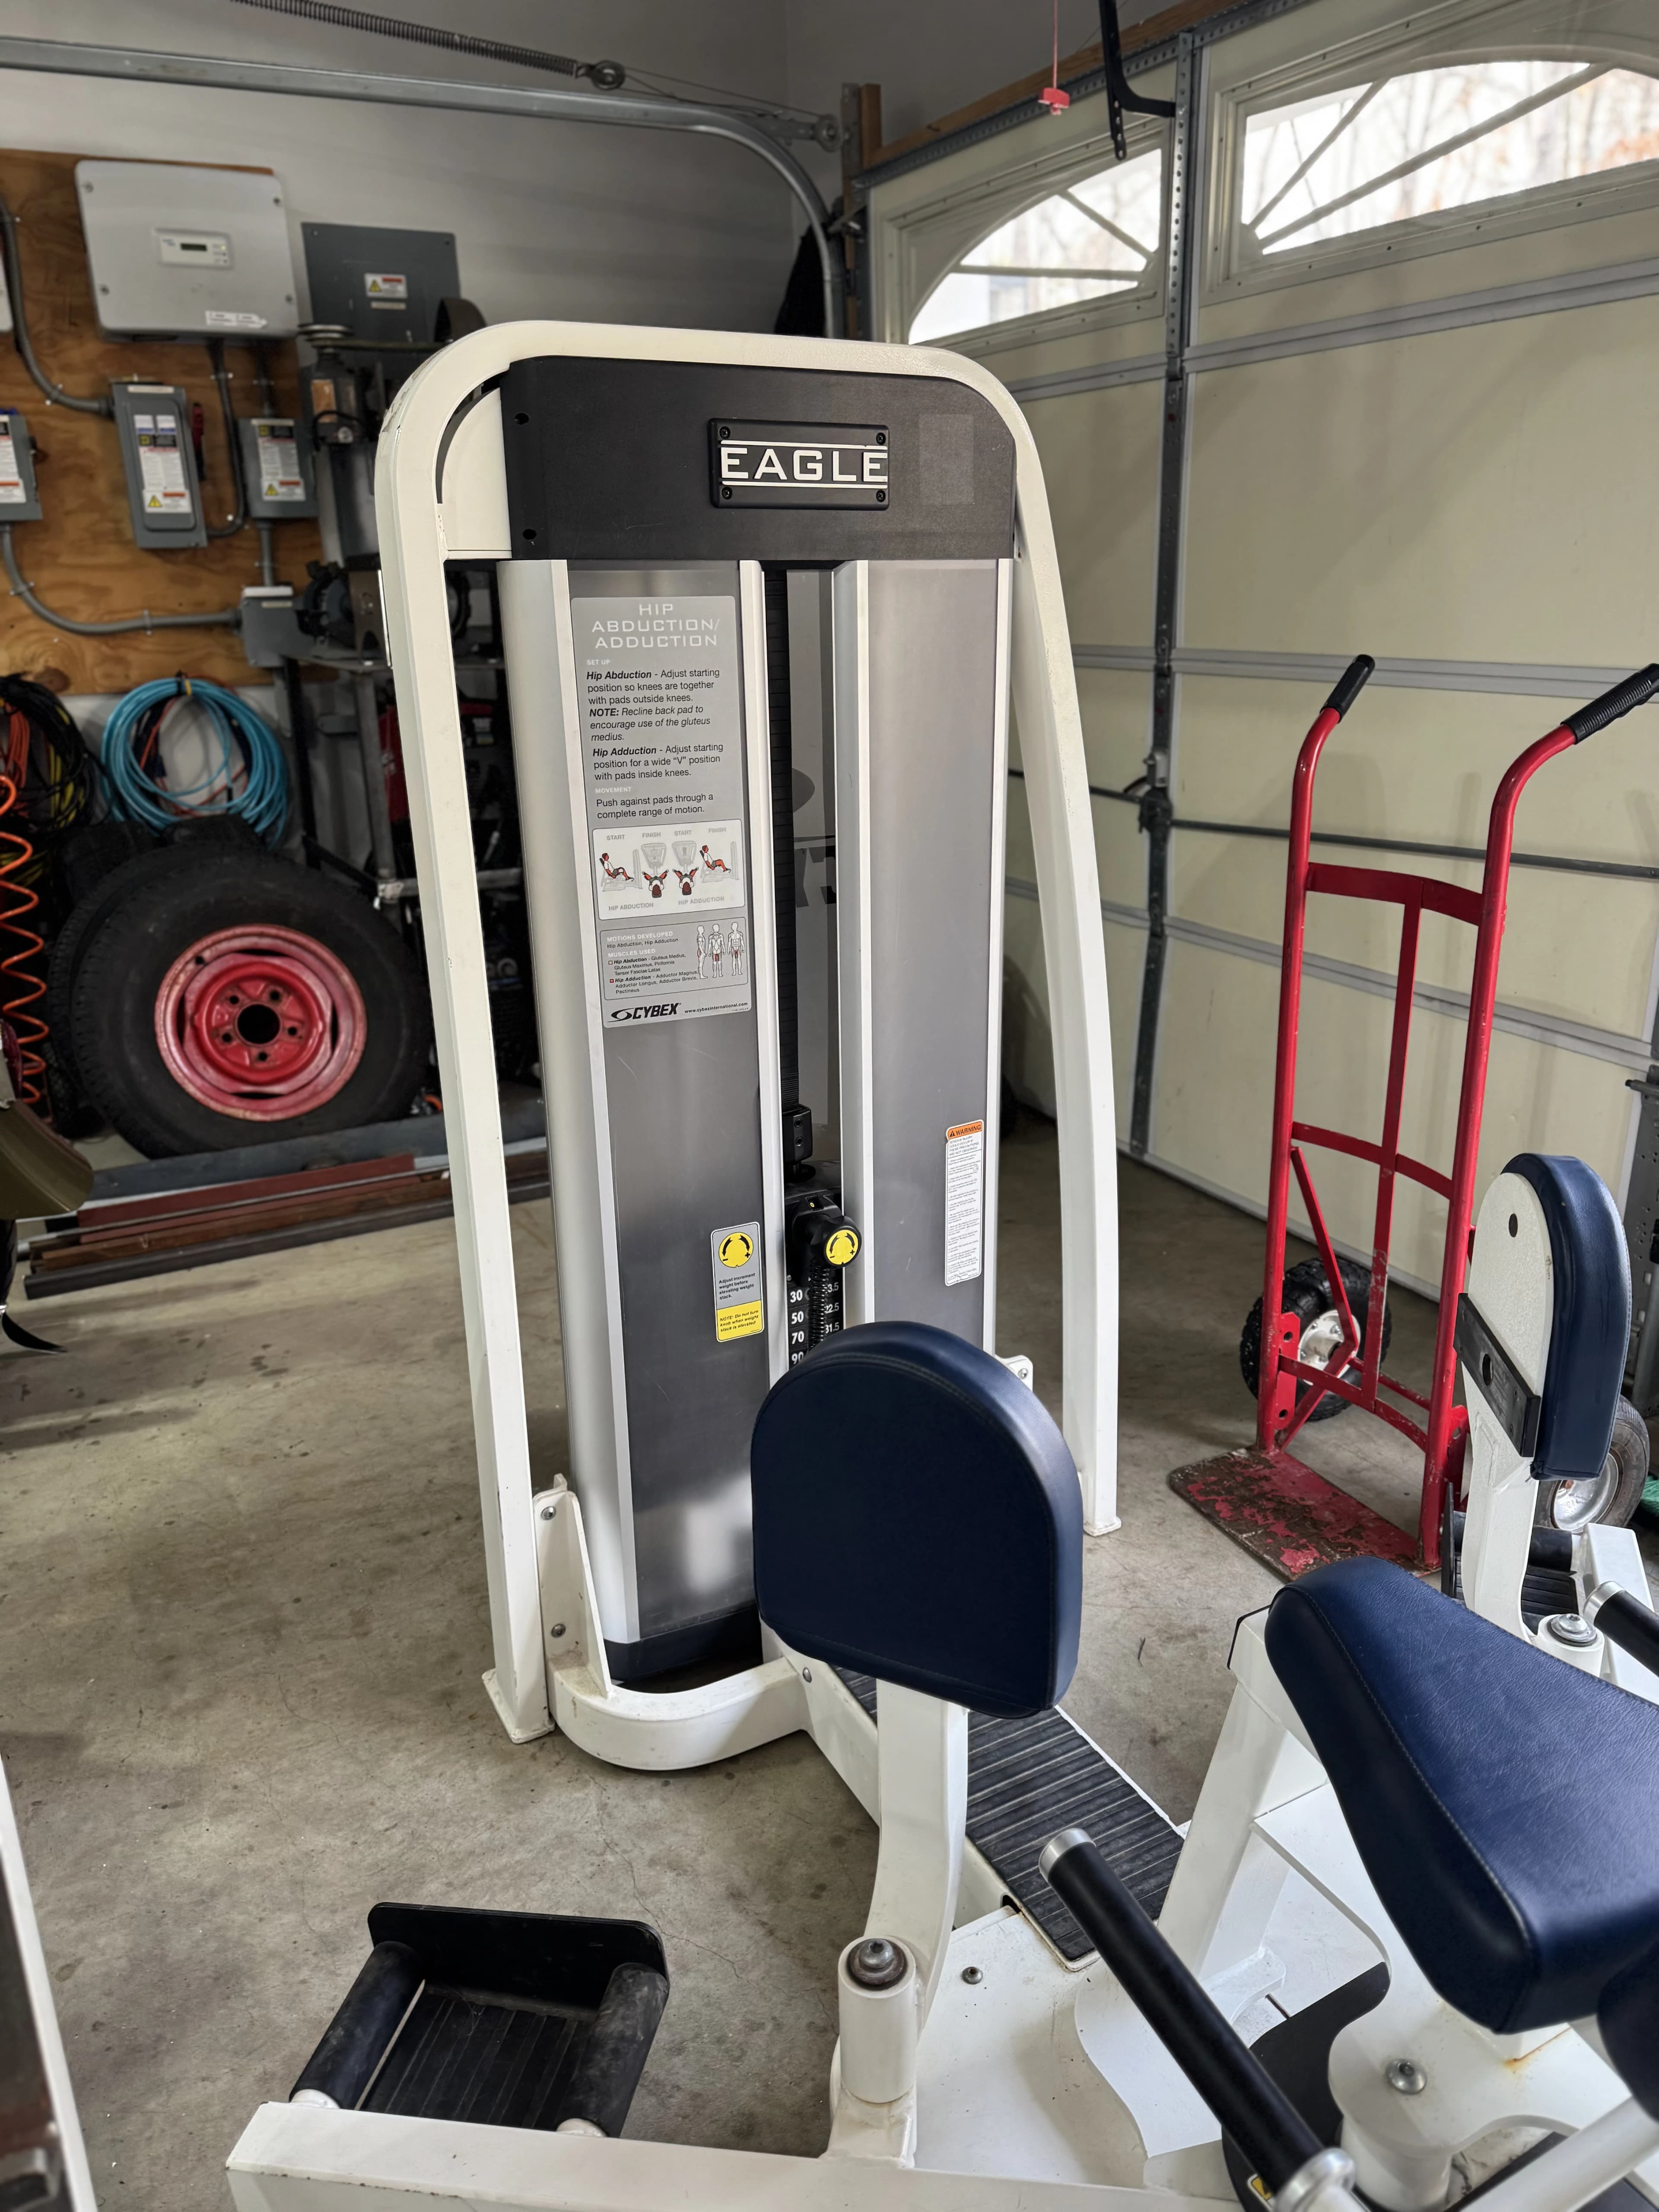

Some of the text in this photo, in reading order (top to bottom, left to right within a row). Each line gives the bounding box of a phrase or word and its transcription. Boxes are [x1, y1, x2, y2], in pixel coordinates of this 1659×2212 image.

[721, 447, 888, 482] EAGLE
[639, 604, 673, 615] HIP
[591, 619, 720, 632] ABDUCTION/
[595, 635, 717, 648] ADDUCTION
[587, 671, 602, 681] Hip
[605, 671, 652, 680] Abduction
[661, 669, 687, 679] Adjust
[689, 668, 720, 677] starting
[588, 683, 622, 693] position
[680, 681, 715, 691] together
[588, 696, 606, 705] with
[609, 696, 630, 706] pads
[632, 695, 664, 703] outside
[589, 708, 619, 717] NOTE:
[622, 707, 652, 716] Recline
[655, 706, 675, 715] back
[677, 706, 693, 715] pad
[590, 721, 636, 729] encourage
[655, 718, 664, 727] of
[681, 718, 711, 727] gluteus
[591, 733, 624, 741] medius.
[593, 748, 608, 758] Hip
[610, 747, 657, 756] Adduction
[665, 745, 691, 754] Adjust
[693, 743, 723, 752] starting
[594, 760, 627, 770] position
[629, 759, 642, 767] for
[689, 756, 720, 765] position
[594, 772, 612, 780] with
[615, 771, 636, 781] pads
[638, 770, 662, 778] inside
[597, 798, 618, 807] Push
[620, 797, 650, 807] against
[653, 796, 673, 805] pads
[675, 794, 706, 802] through
[597, 810, 636, 819] complete
[675, 806, 705, 814] motion.
[632, 1002, 748, 1019] CYBEX www.cybexinternational.com
[956, 1125, 981, 1135] WARNING
[790, 1289, 803, 1303] 30
[791, 1311, 804, 1324] 50
[791, 1331, 804, 1344] 70
[791, 1351, 804, 1365] 90
